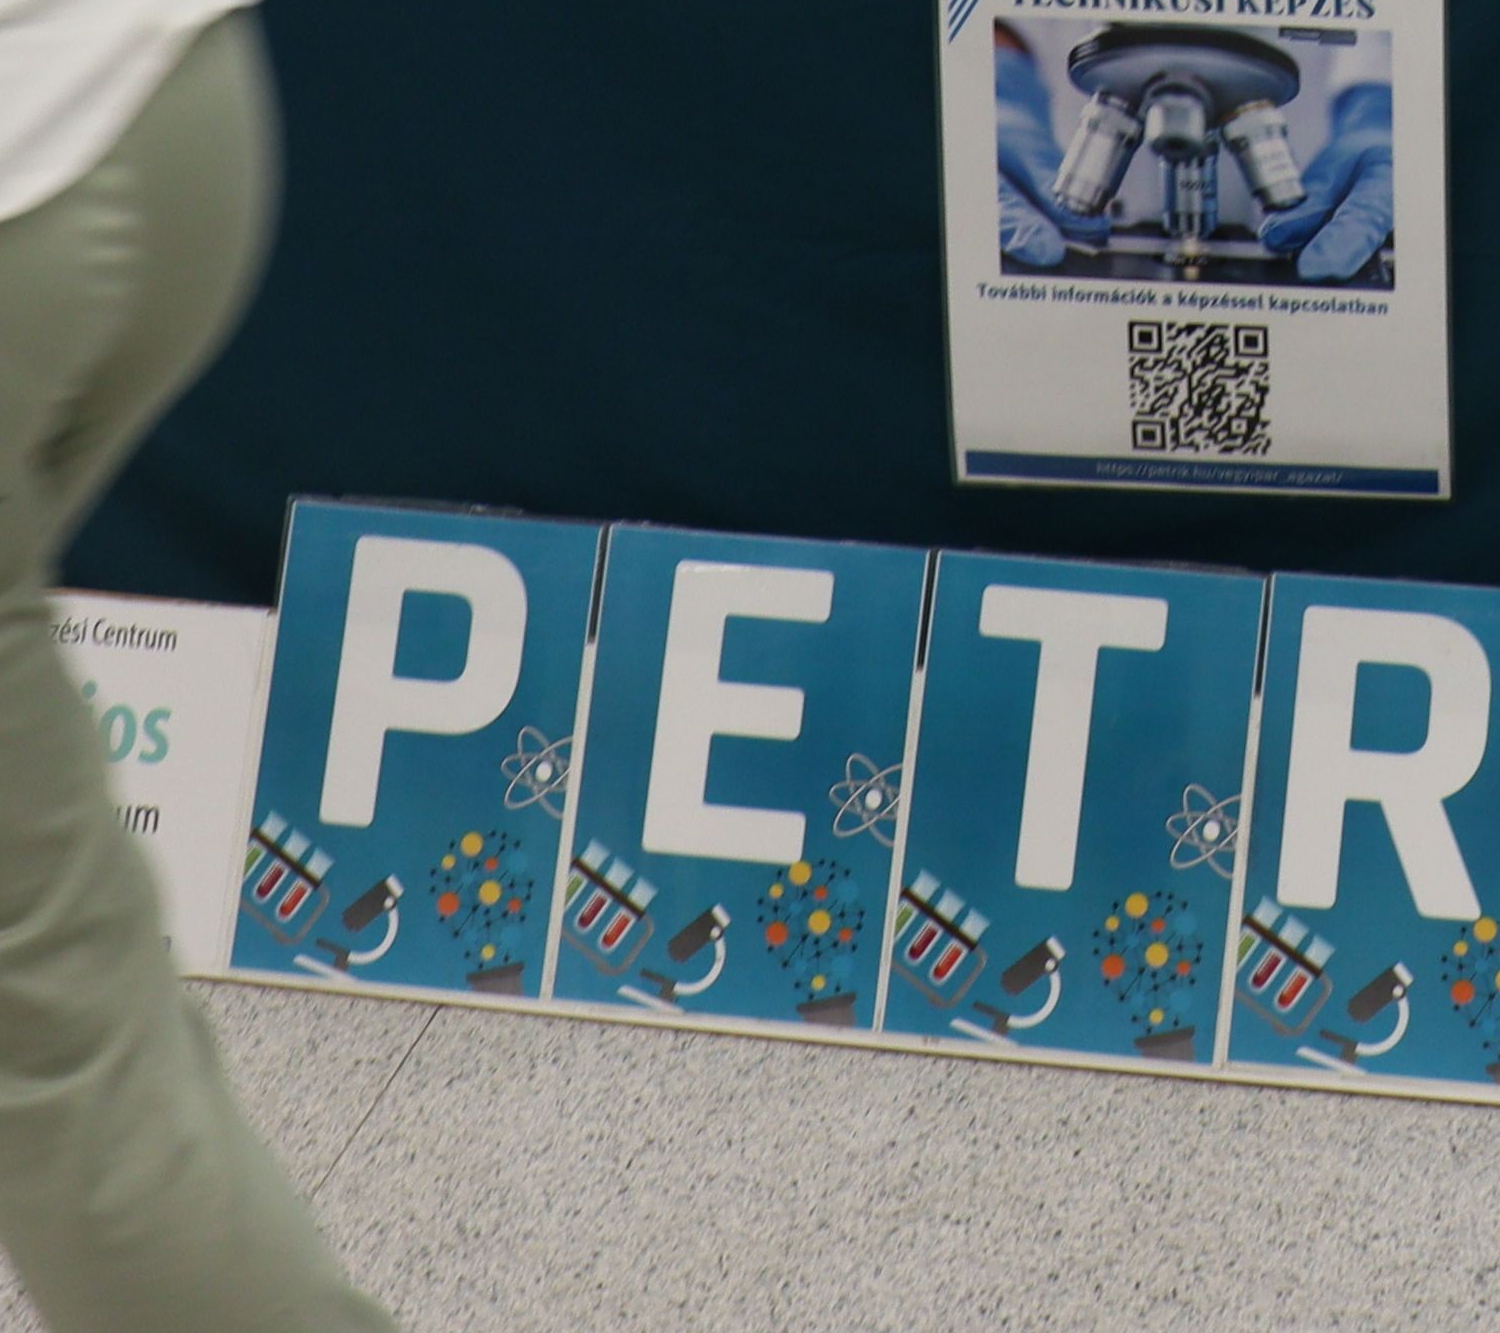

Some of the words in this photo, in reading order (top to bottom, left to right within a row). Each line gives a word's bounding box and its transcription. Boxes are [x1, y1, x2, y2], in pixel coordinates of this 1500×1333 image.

[976, 281, 1046, 301] További
[1162, 295, 1172, 306] a
[1177, 290, 1264, 312] képzéssel
[1269, 294, 1389, 316] kapcsolatban
[50, 616, 89, 645] zési
[92, 617, 178, 652] Centrum
